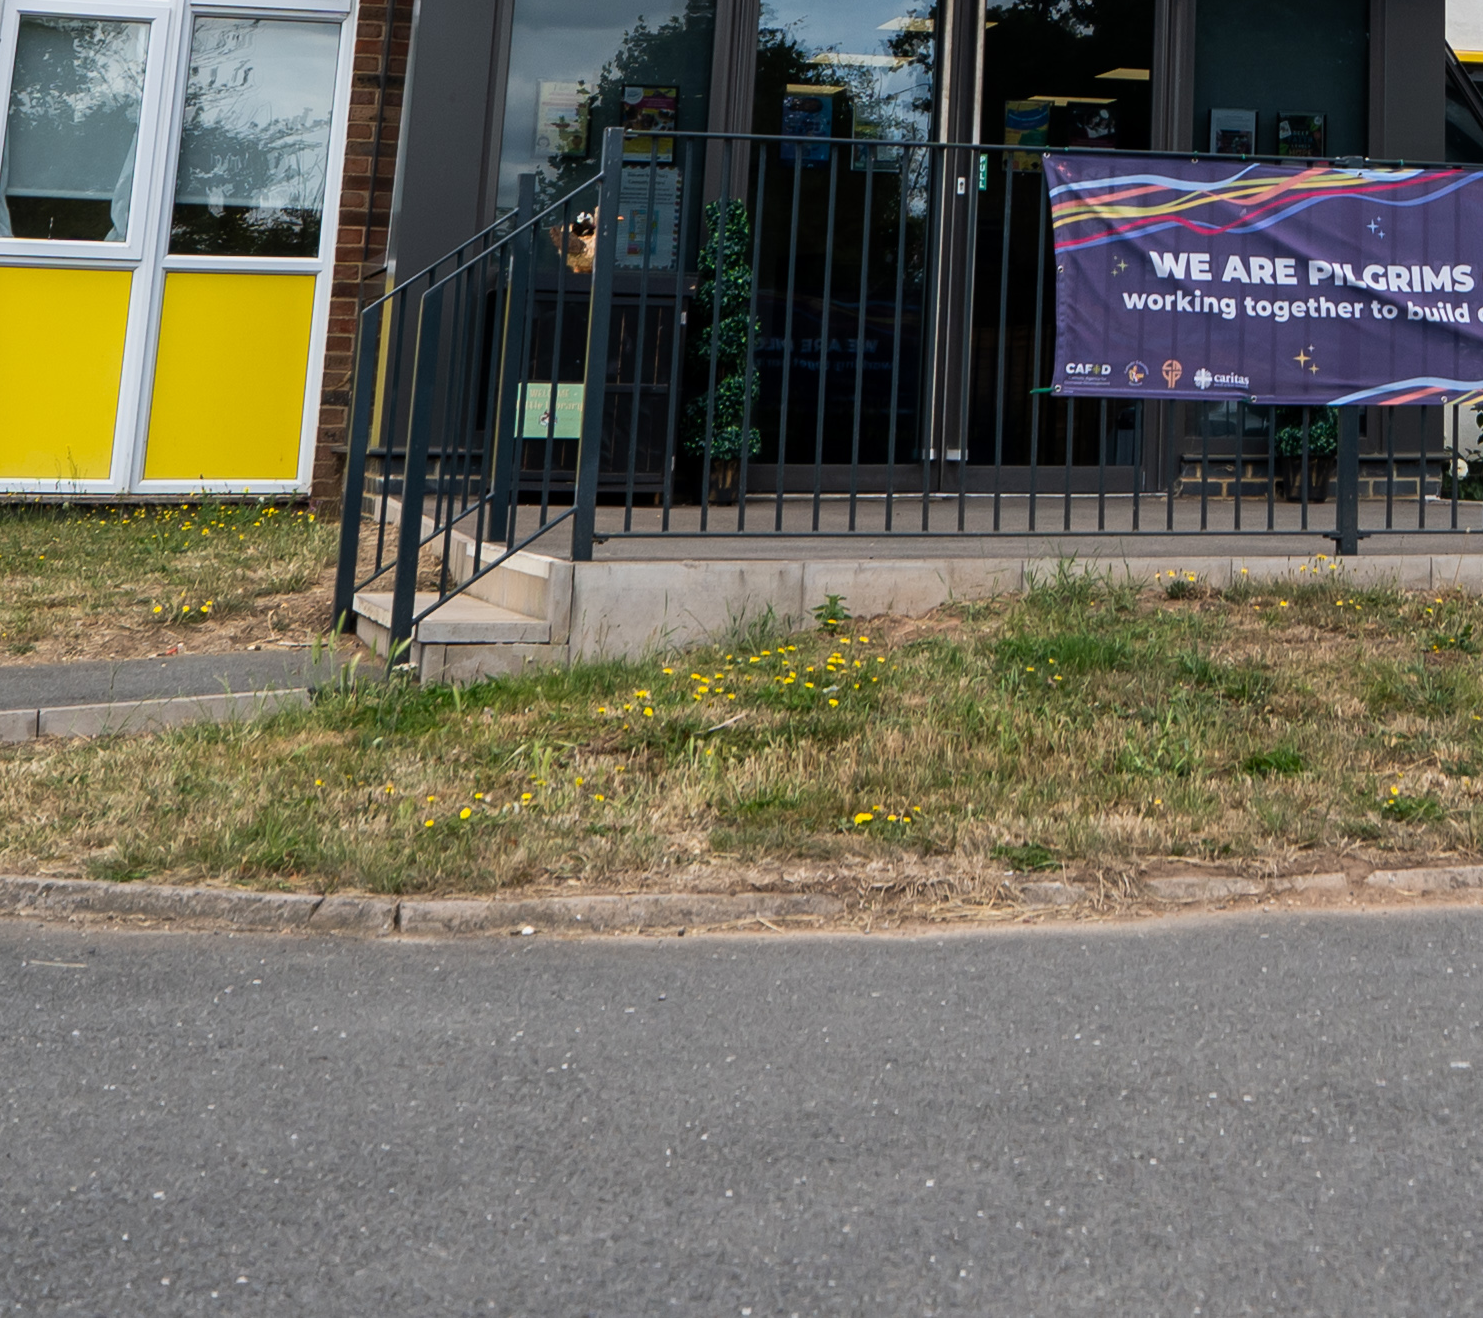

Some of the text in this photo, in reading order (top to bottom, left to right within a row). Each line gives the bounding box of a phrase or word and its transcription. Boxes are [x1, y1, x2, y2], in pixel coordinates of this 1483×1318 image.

[1149, 251, 1212, 281] WE
[1222, 255, 1298, 285] ARE
[1308, 259, 1475, 293] PILGRIMS
[1122, 290, 1237, 319] working
[1244, 296, 1363, 322] together
[1371, 300, 1398, 320] to
[1407, 301, 1471, 324] build
[1214, 372, 1249, 385] caritas
